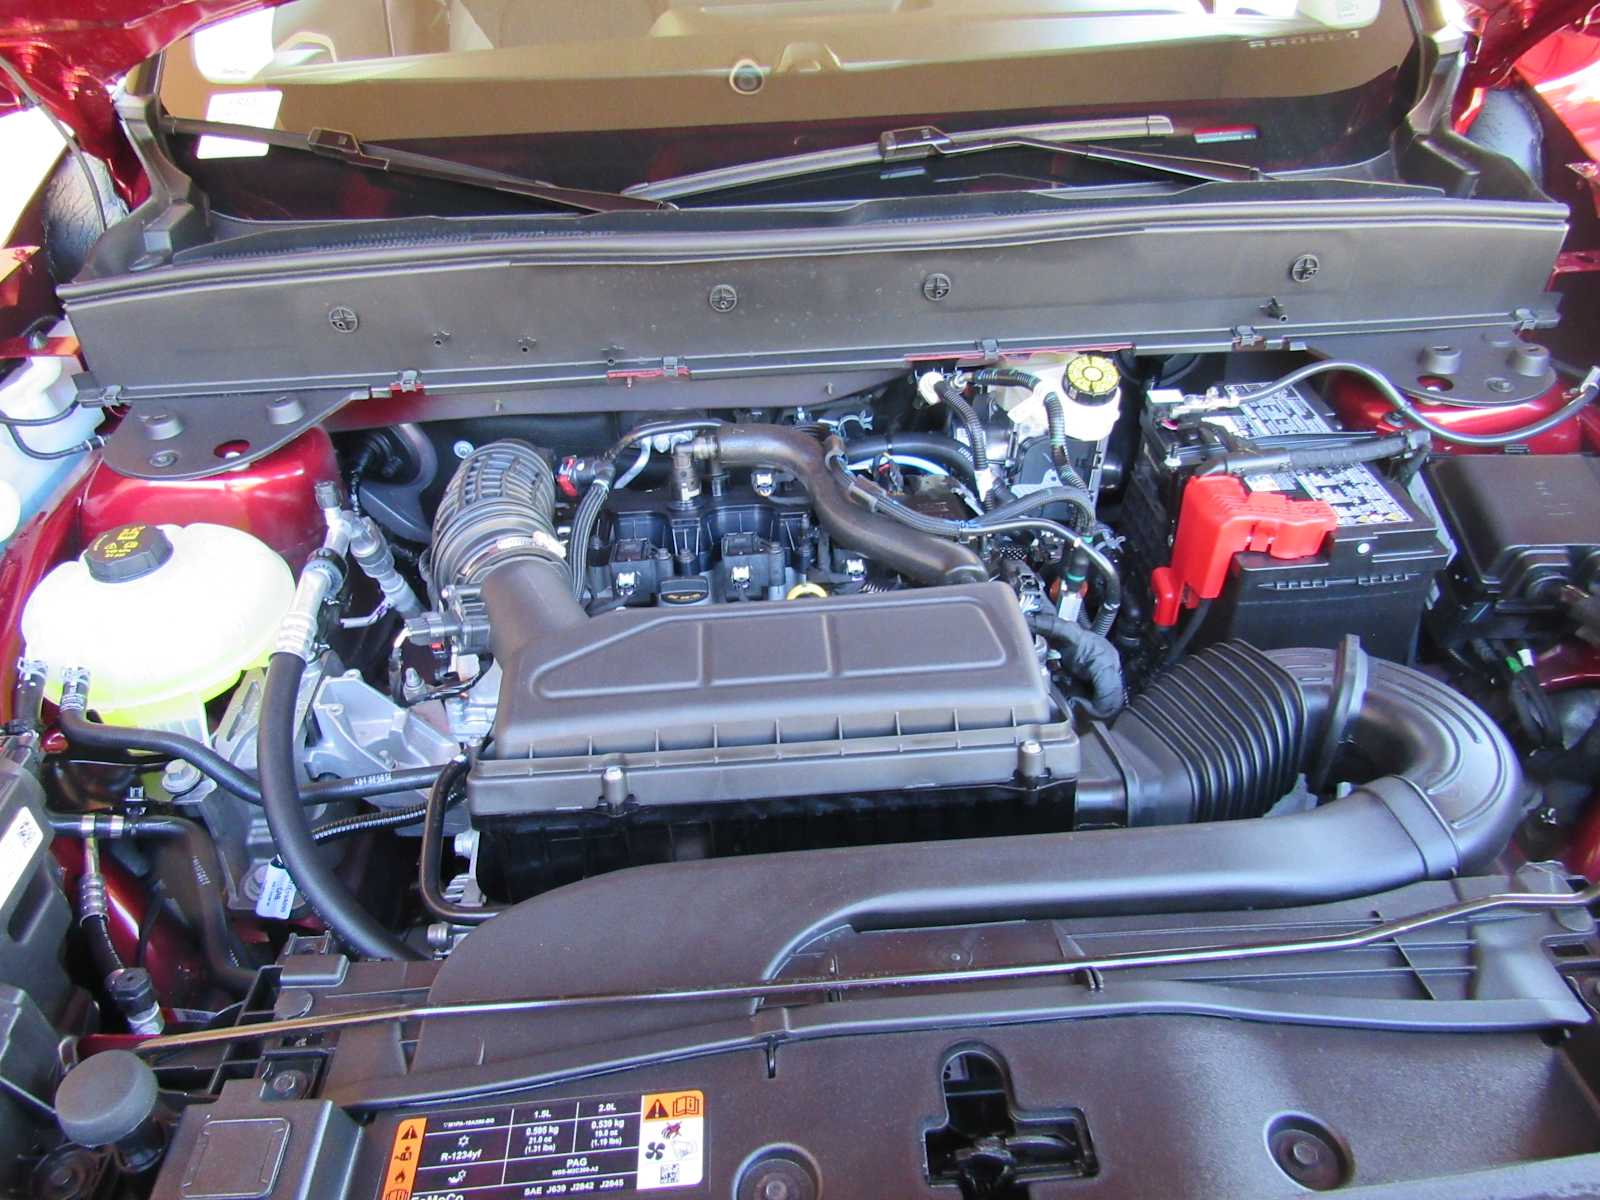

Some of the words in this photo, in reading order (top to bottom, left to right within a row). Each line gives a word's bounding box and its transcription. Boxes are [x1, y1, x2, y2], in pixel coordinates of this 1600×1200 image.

[598, 1103, 616, 1112] 2.0L
[614, 1119, 624, 1128] kg
[548, 1126, 559, 1135] kg
[440, 1148, 483, 1161] R-1234yf
[566, 1157, 587, 1167] PAG
[524, 1186, 542, 1196] SAE
